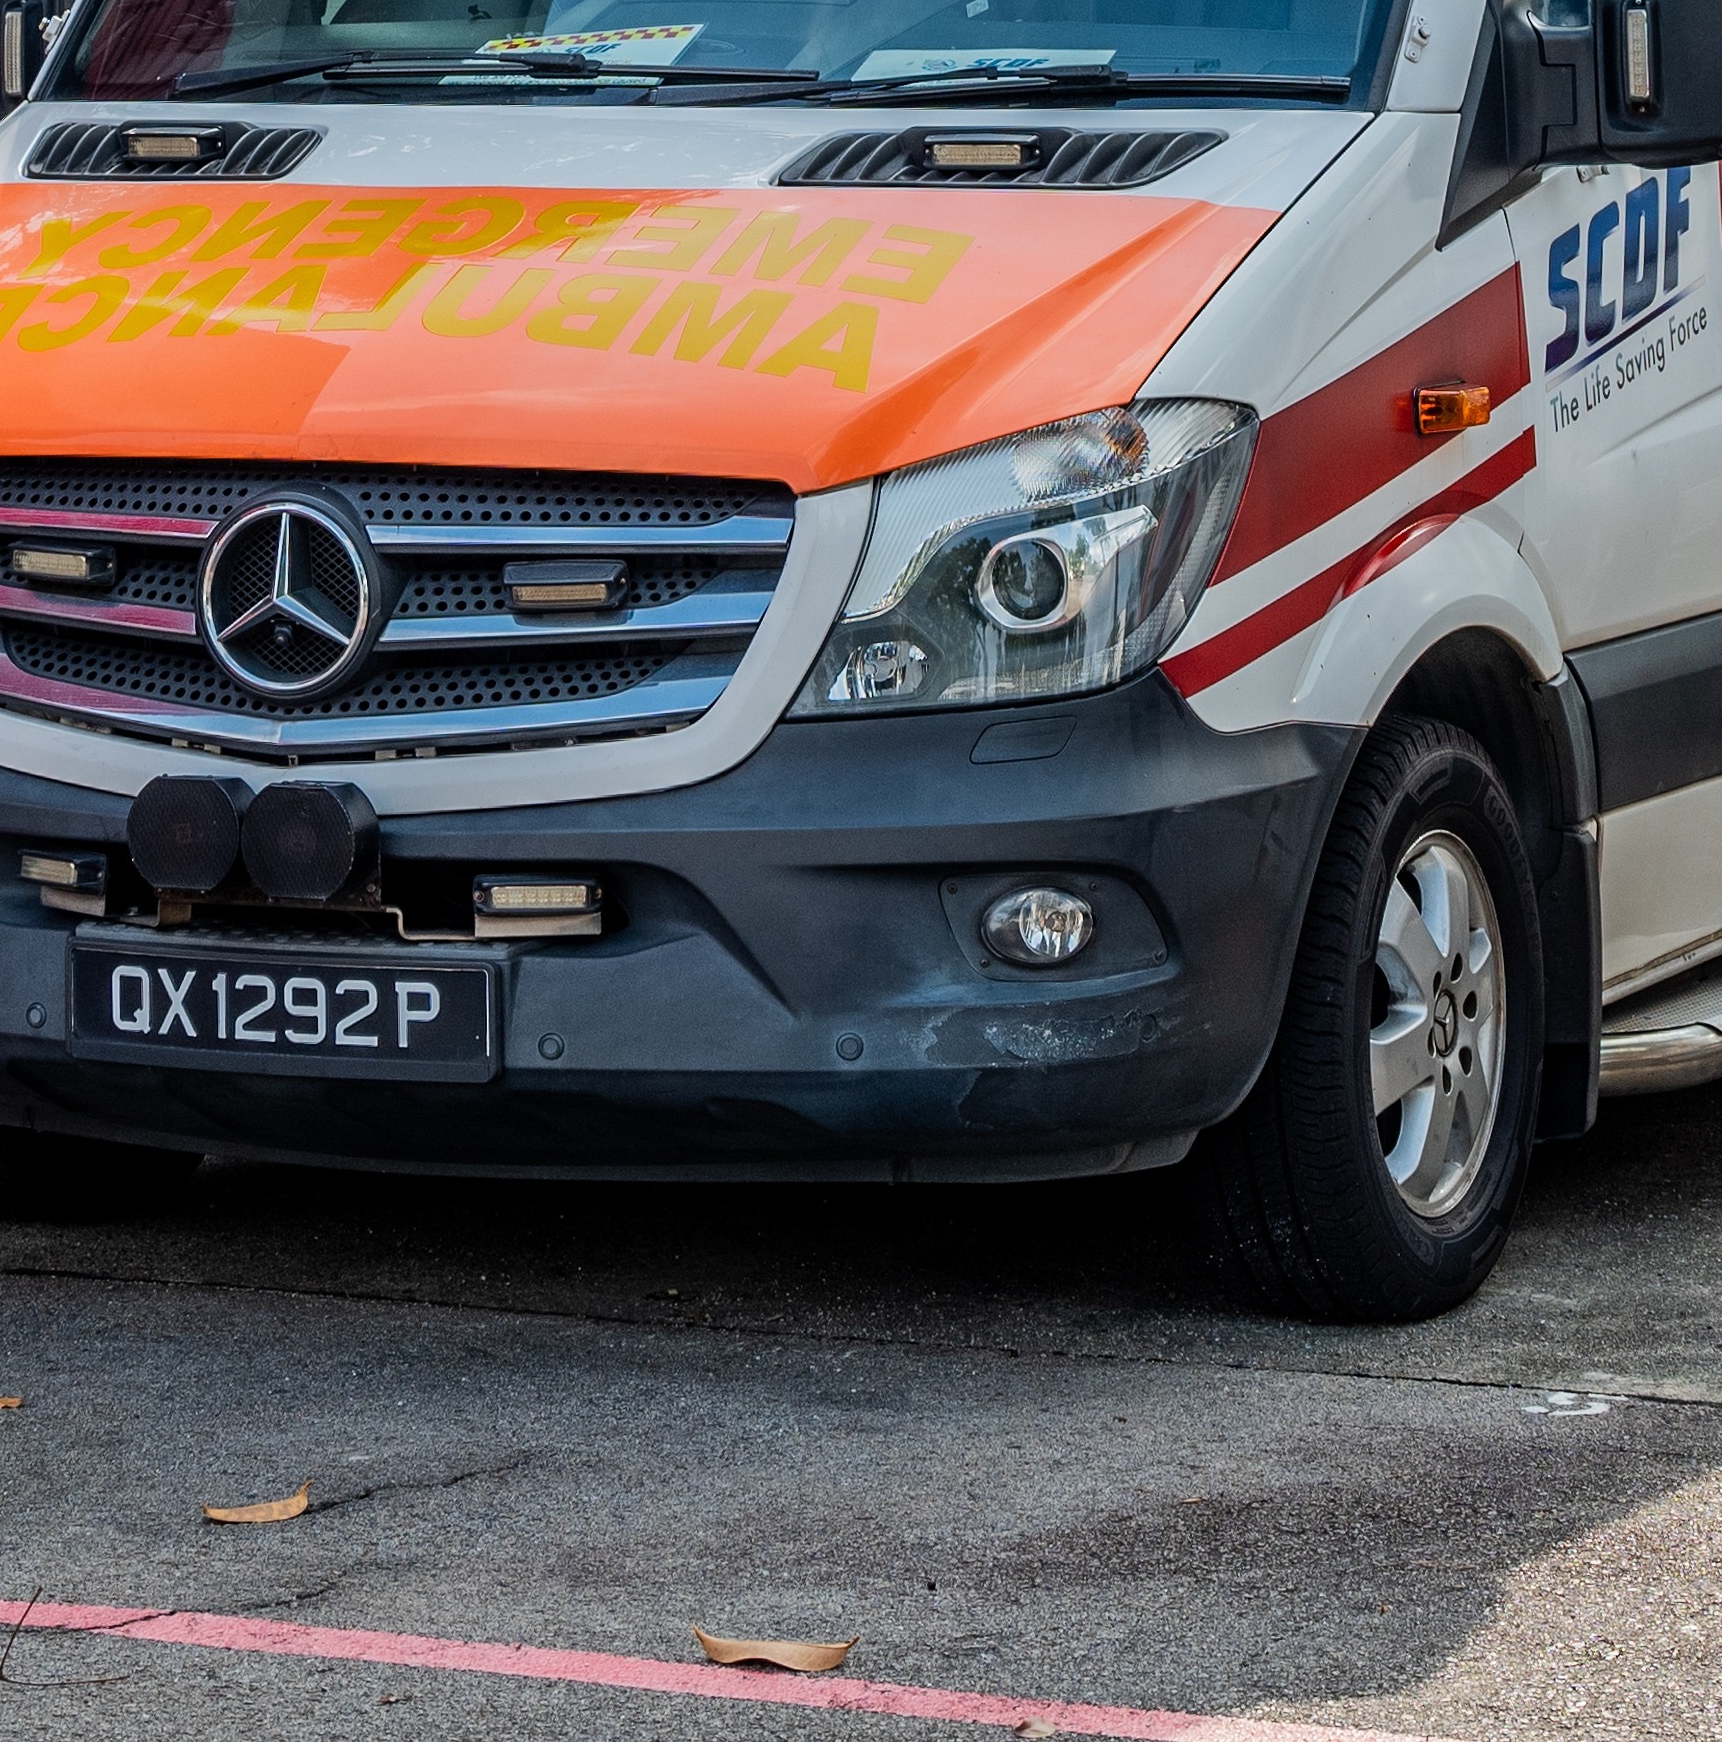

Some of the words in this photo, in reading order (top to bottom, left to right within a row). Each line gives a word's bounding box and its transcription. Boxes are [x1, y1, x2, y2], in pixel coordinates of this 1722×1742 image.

[1544, 165, 1692, 374] SCDF
[1549, 389, 1580, 434] The
[1583, 364, 1612, 413] Life
[1615, 334, 1666, 391] Saving
[1668, 306, 1708, 353] Force
[111, 964, 441, 1049] QX1292P
